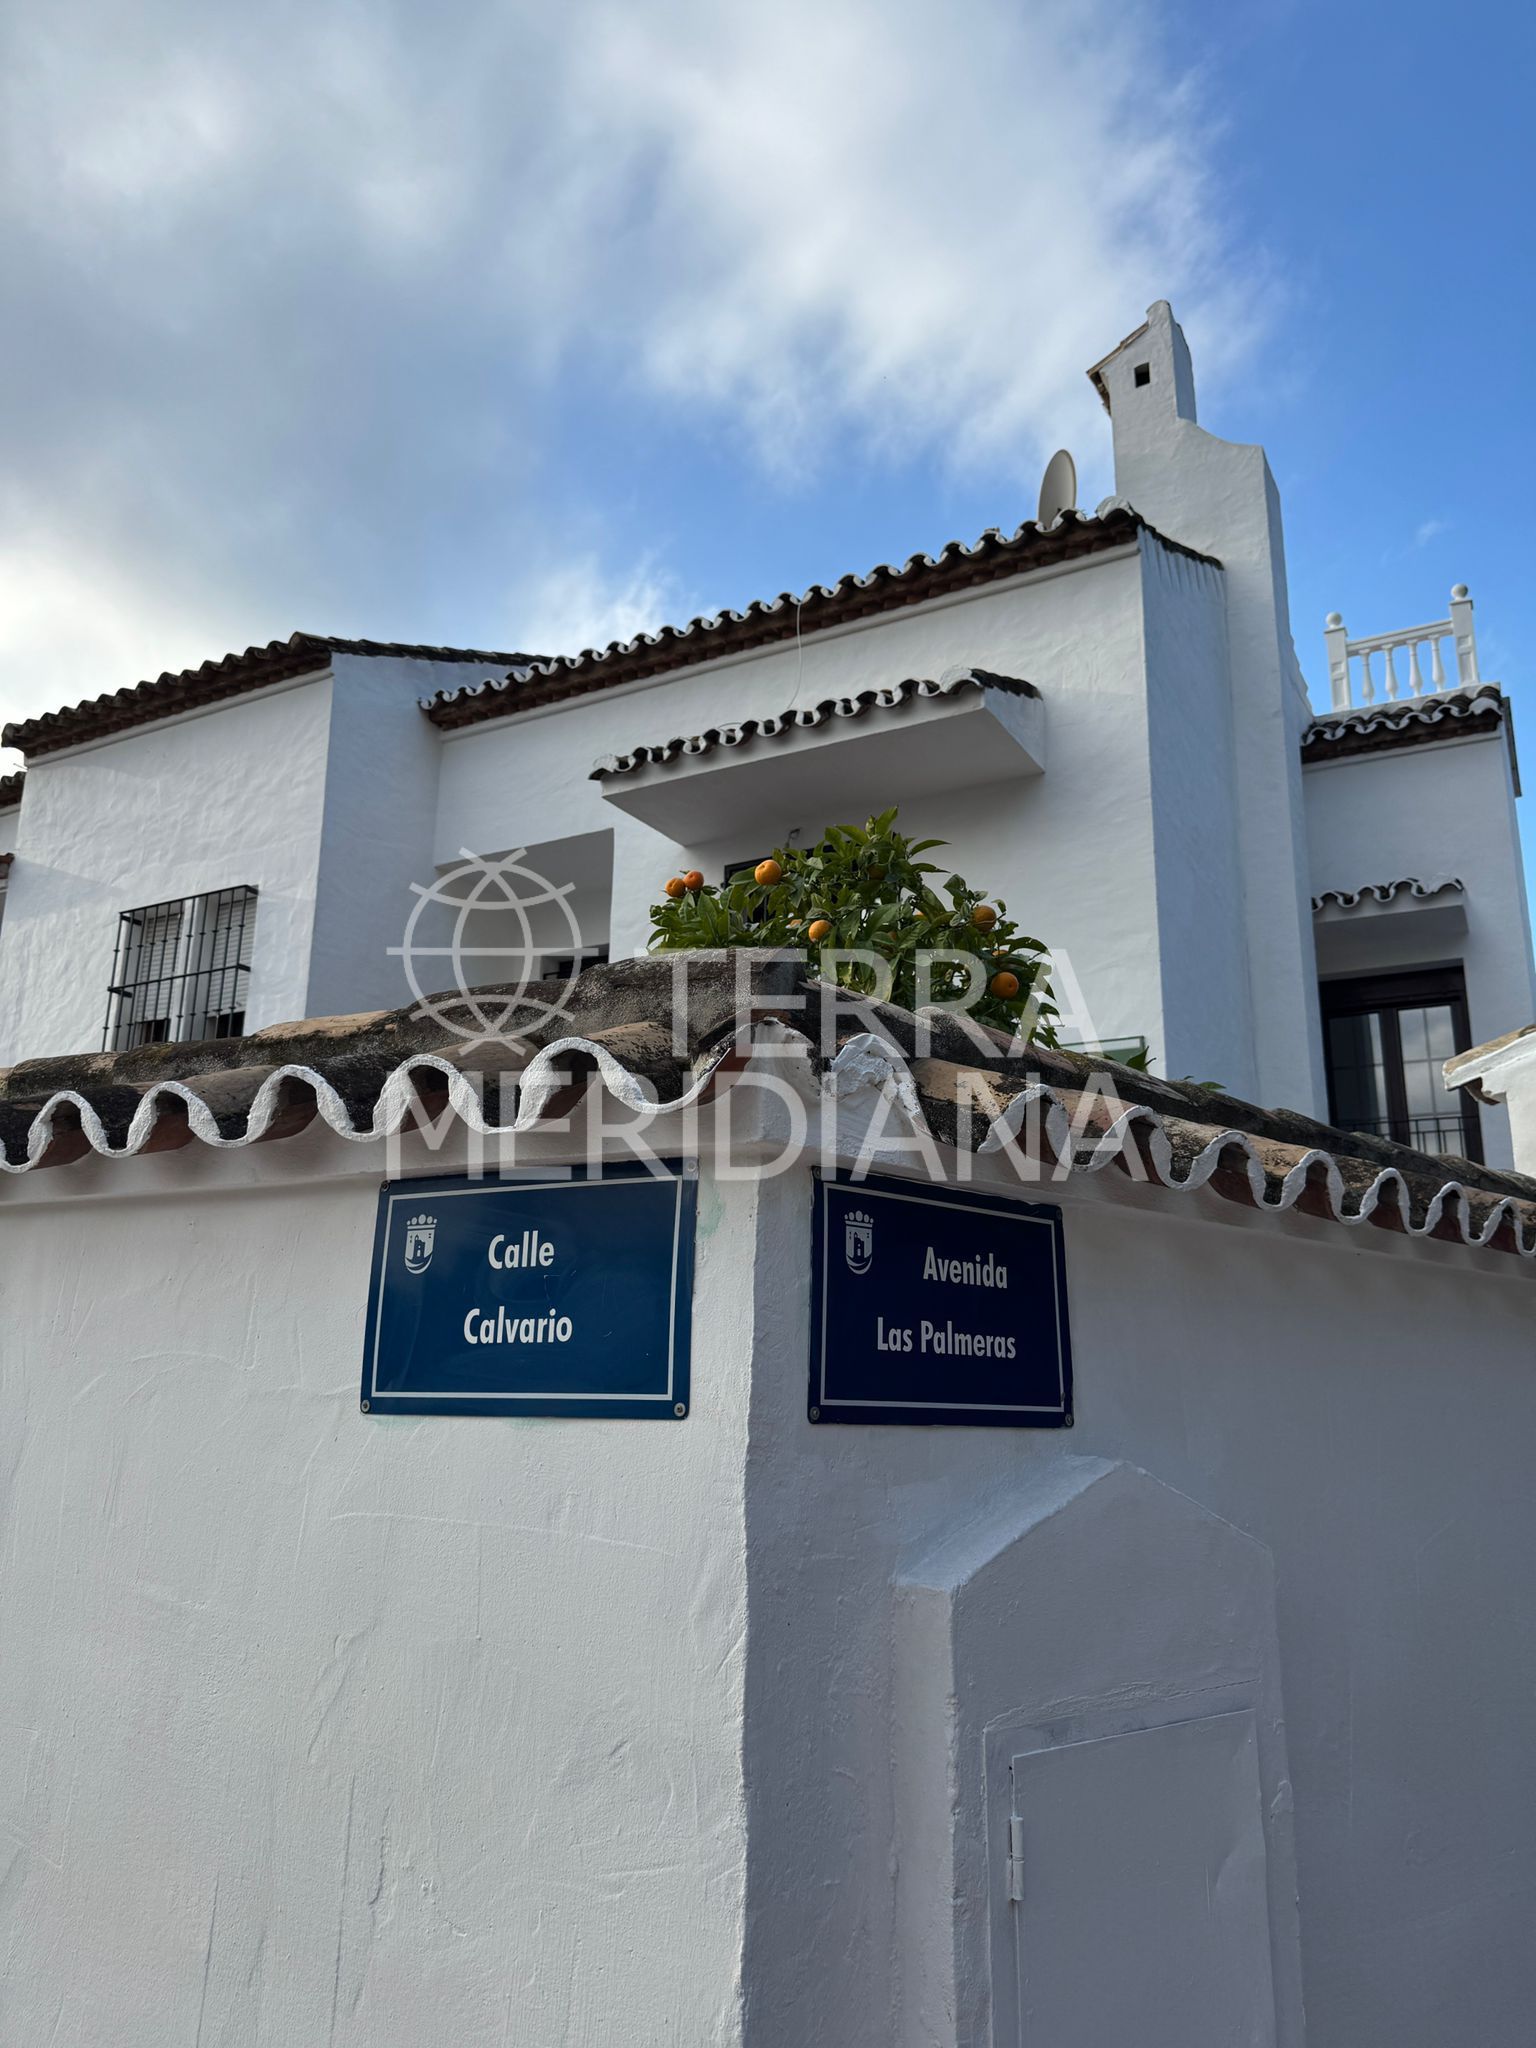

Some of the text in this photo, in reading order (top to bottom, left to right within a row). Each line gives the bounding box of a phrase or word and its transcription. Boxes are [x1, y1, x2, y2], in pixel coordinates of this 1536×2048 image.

[488, 1230, 555, 1270] Calle
[922, 1246, 1008, 1289] Avenida
[463, 1305, 573, 1345] Calvario
[876, 1316, 1016, 1359] Las Palmeras
